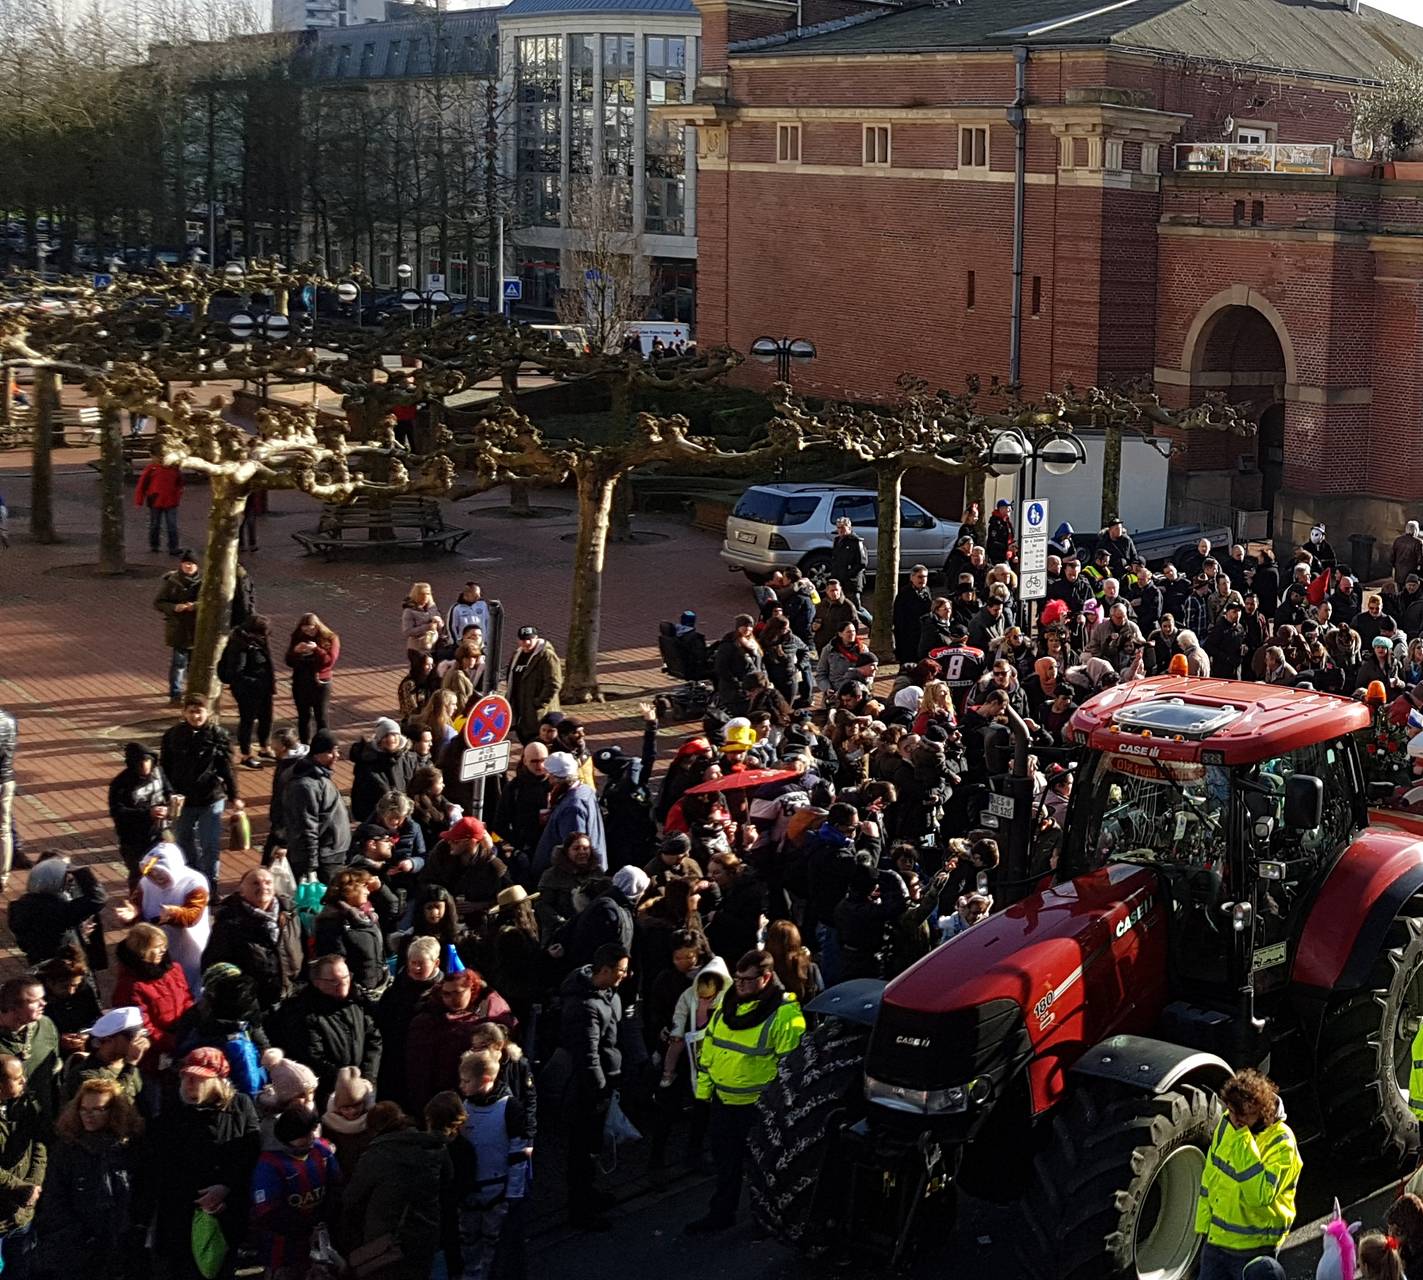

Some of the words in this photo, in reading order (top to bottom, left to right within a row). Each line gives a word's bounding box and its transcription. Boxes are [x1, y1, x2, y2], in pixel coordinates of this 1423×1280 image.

[946, 655, 964, 680] 8
[1119, 743, 1148, 756] CASE
[1034, 990, 1054, 1018] 180
[896, 1035, 921, 1046] CASE
